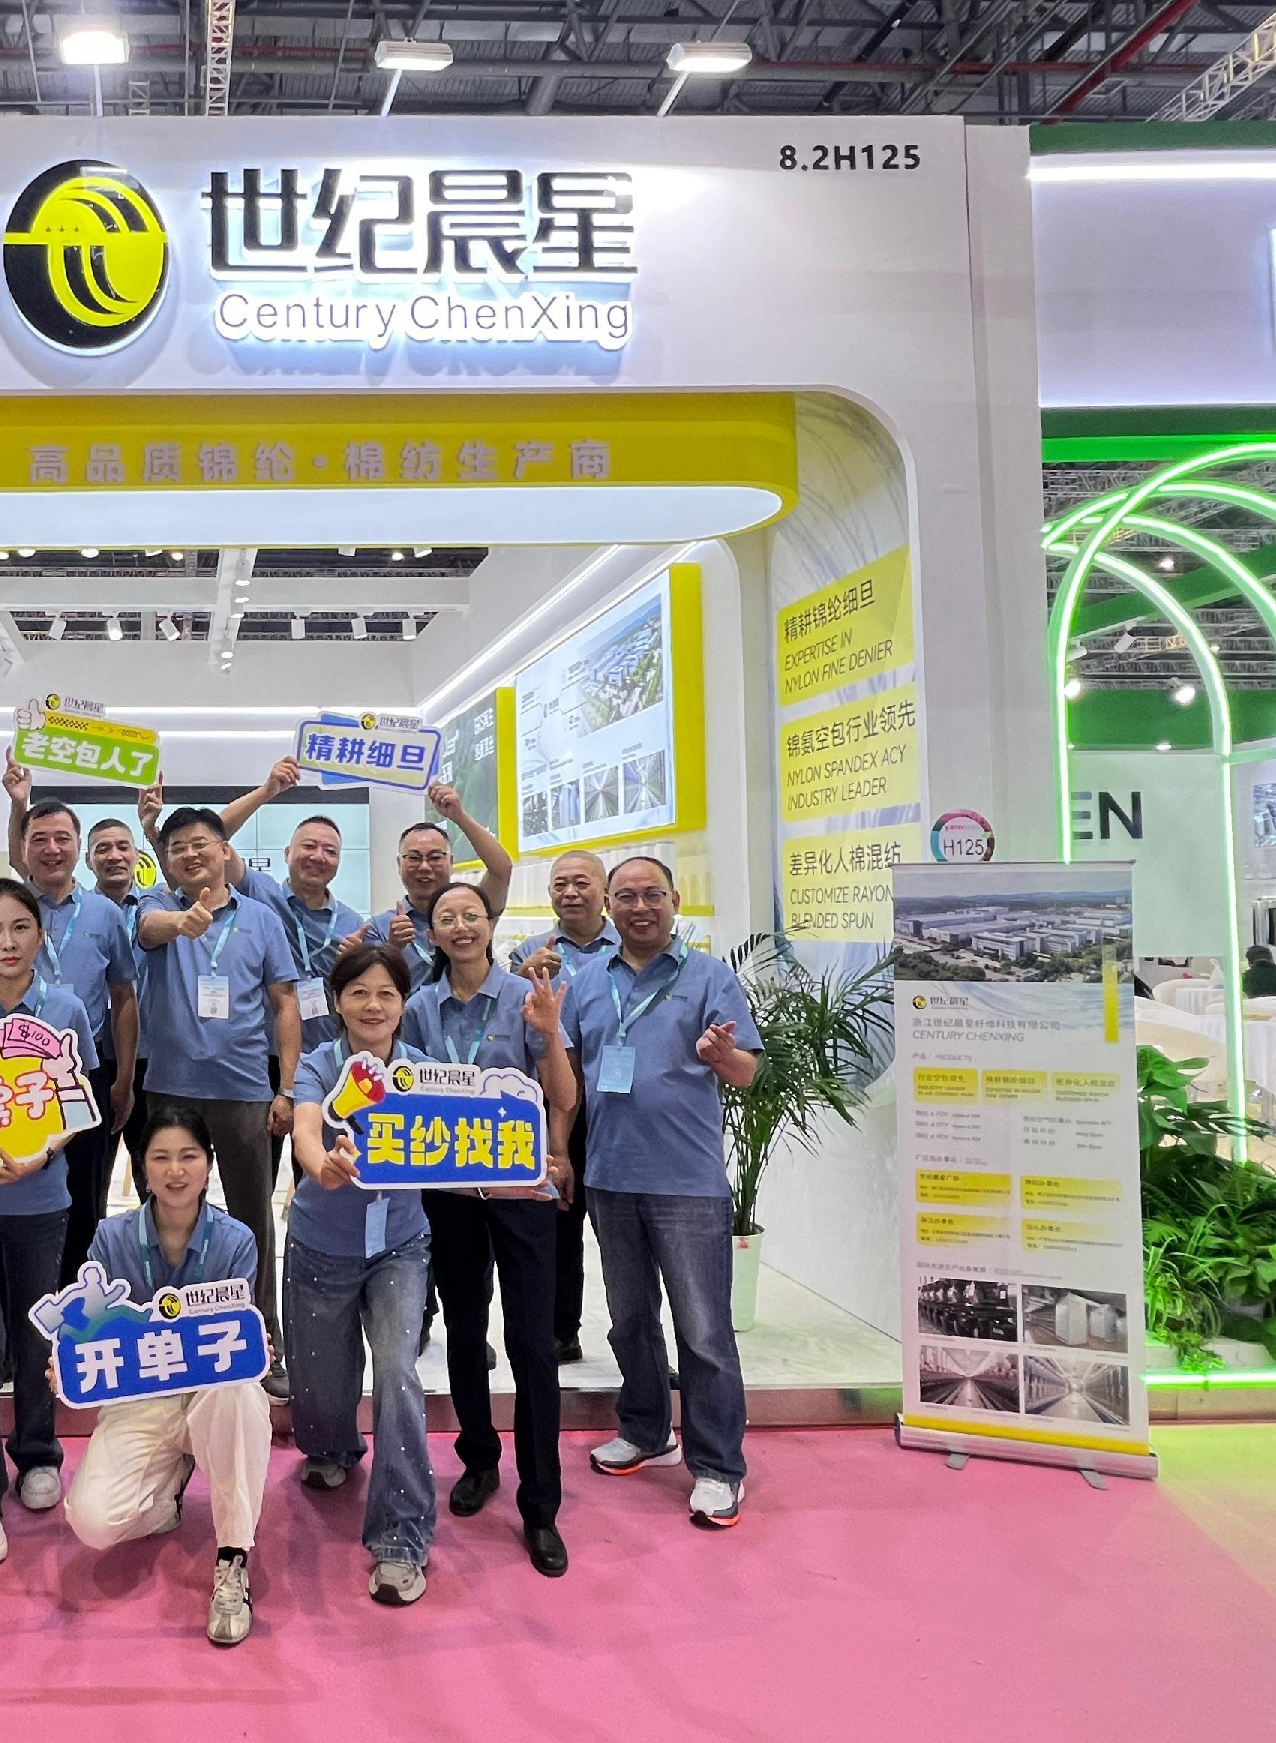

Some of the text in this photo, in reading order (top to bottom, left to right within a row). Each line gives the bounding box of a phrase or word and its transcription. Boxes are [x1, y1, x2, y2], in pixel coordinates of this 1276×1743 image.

[779, 145, 921, 171] 8.2H125
[201, 168, 638, 277] 世纪晨星
[219, 294, 630, 339] Century ChenXing
[29, 440, 612, 483] 高品质锦纶·棉纺生产商
[784, 580, 875, 644] 精耕锦纶细旦
[785, 628, 853, 671] EXPERTISE IN
[785, 639, 893, 695] NYLON FINE DENIER
[787, 700, 916, 758] 锦氨空包行业领先
[22, 732, 154, 777] 老空包人了
[306, 733, 426, 771] 精耕细旦
[787, 744, 906, 787] NYLON SPANDEX ACY
[787, 776, 887, 811] INDUSTRY LEADER
[789, 841, 901, 876] 差异化人棉混纺
[943, 838, 985, 856] H125
[790, 884, 850, 905] CUSTOMIZE
[791, 912, 874, 930] BLENDED SPUN
[912, 1029, 1025, 1042] CENTURY CHENXING
[420, 1069, 475, 1087] 世纪晨星
[367, 1112, 535, 1170] 买纱找我
[186, 1285, 245, 1306] 世纪晨星
[74, 1320, 247, 1394] 开单子
